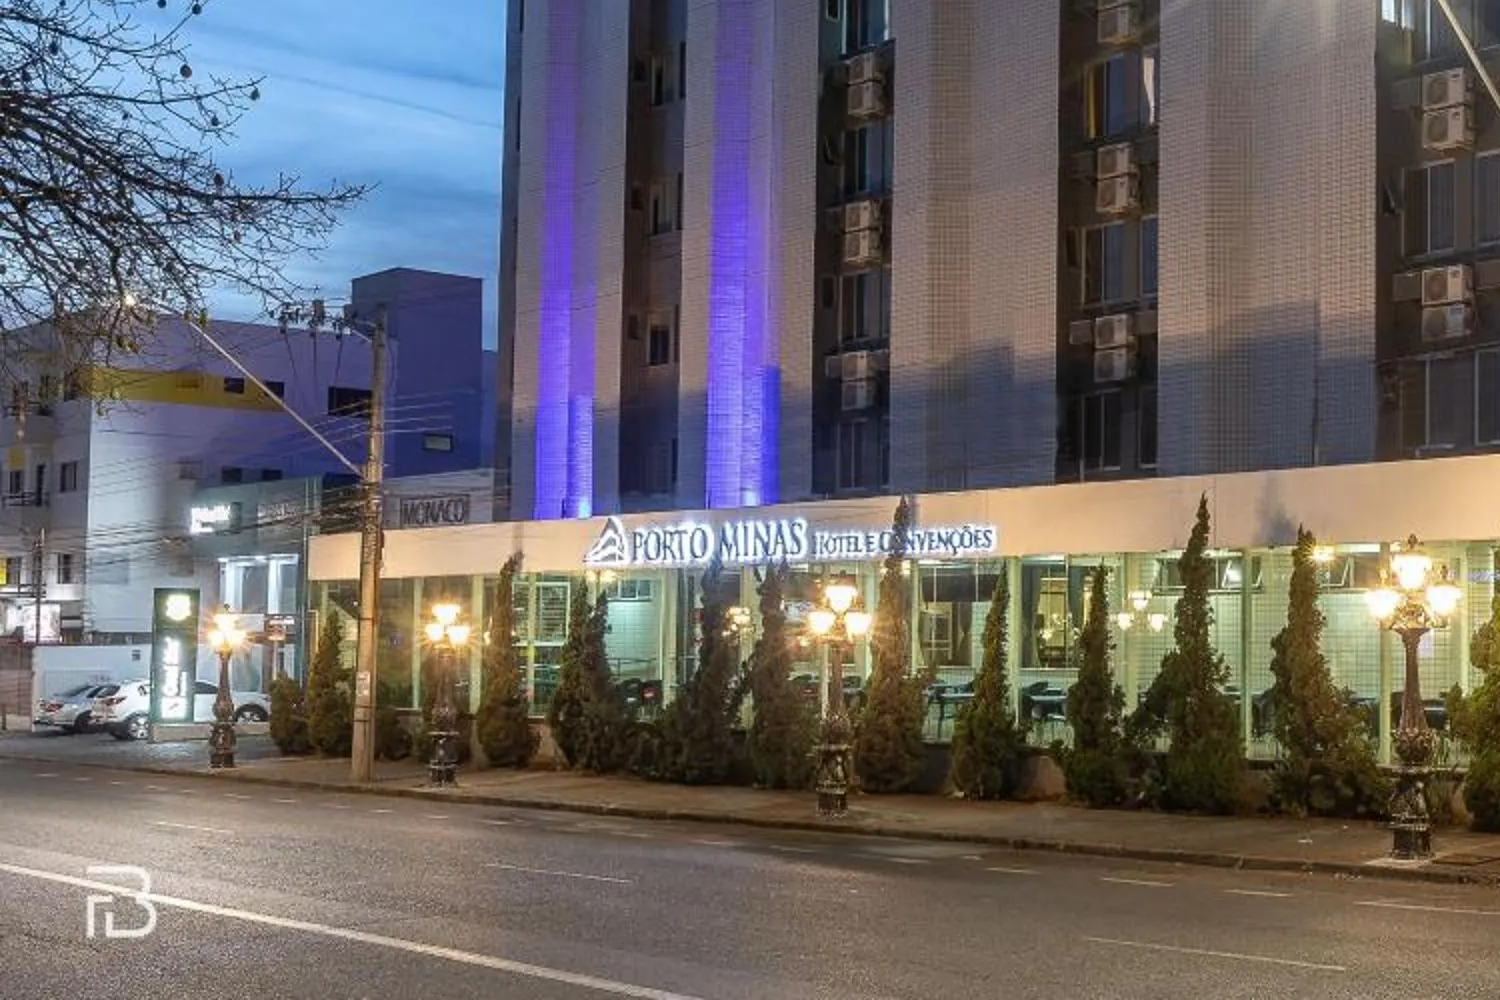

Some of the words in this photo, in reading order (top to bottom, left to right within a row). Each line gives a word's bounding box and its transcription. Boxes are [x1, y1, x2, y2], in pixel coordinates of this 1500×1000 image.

[631, 525, 708, 562] PORTO
[719, 518, 804, 559] MINAS
[879, 526, 993, 556] CNVENÇÕES
